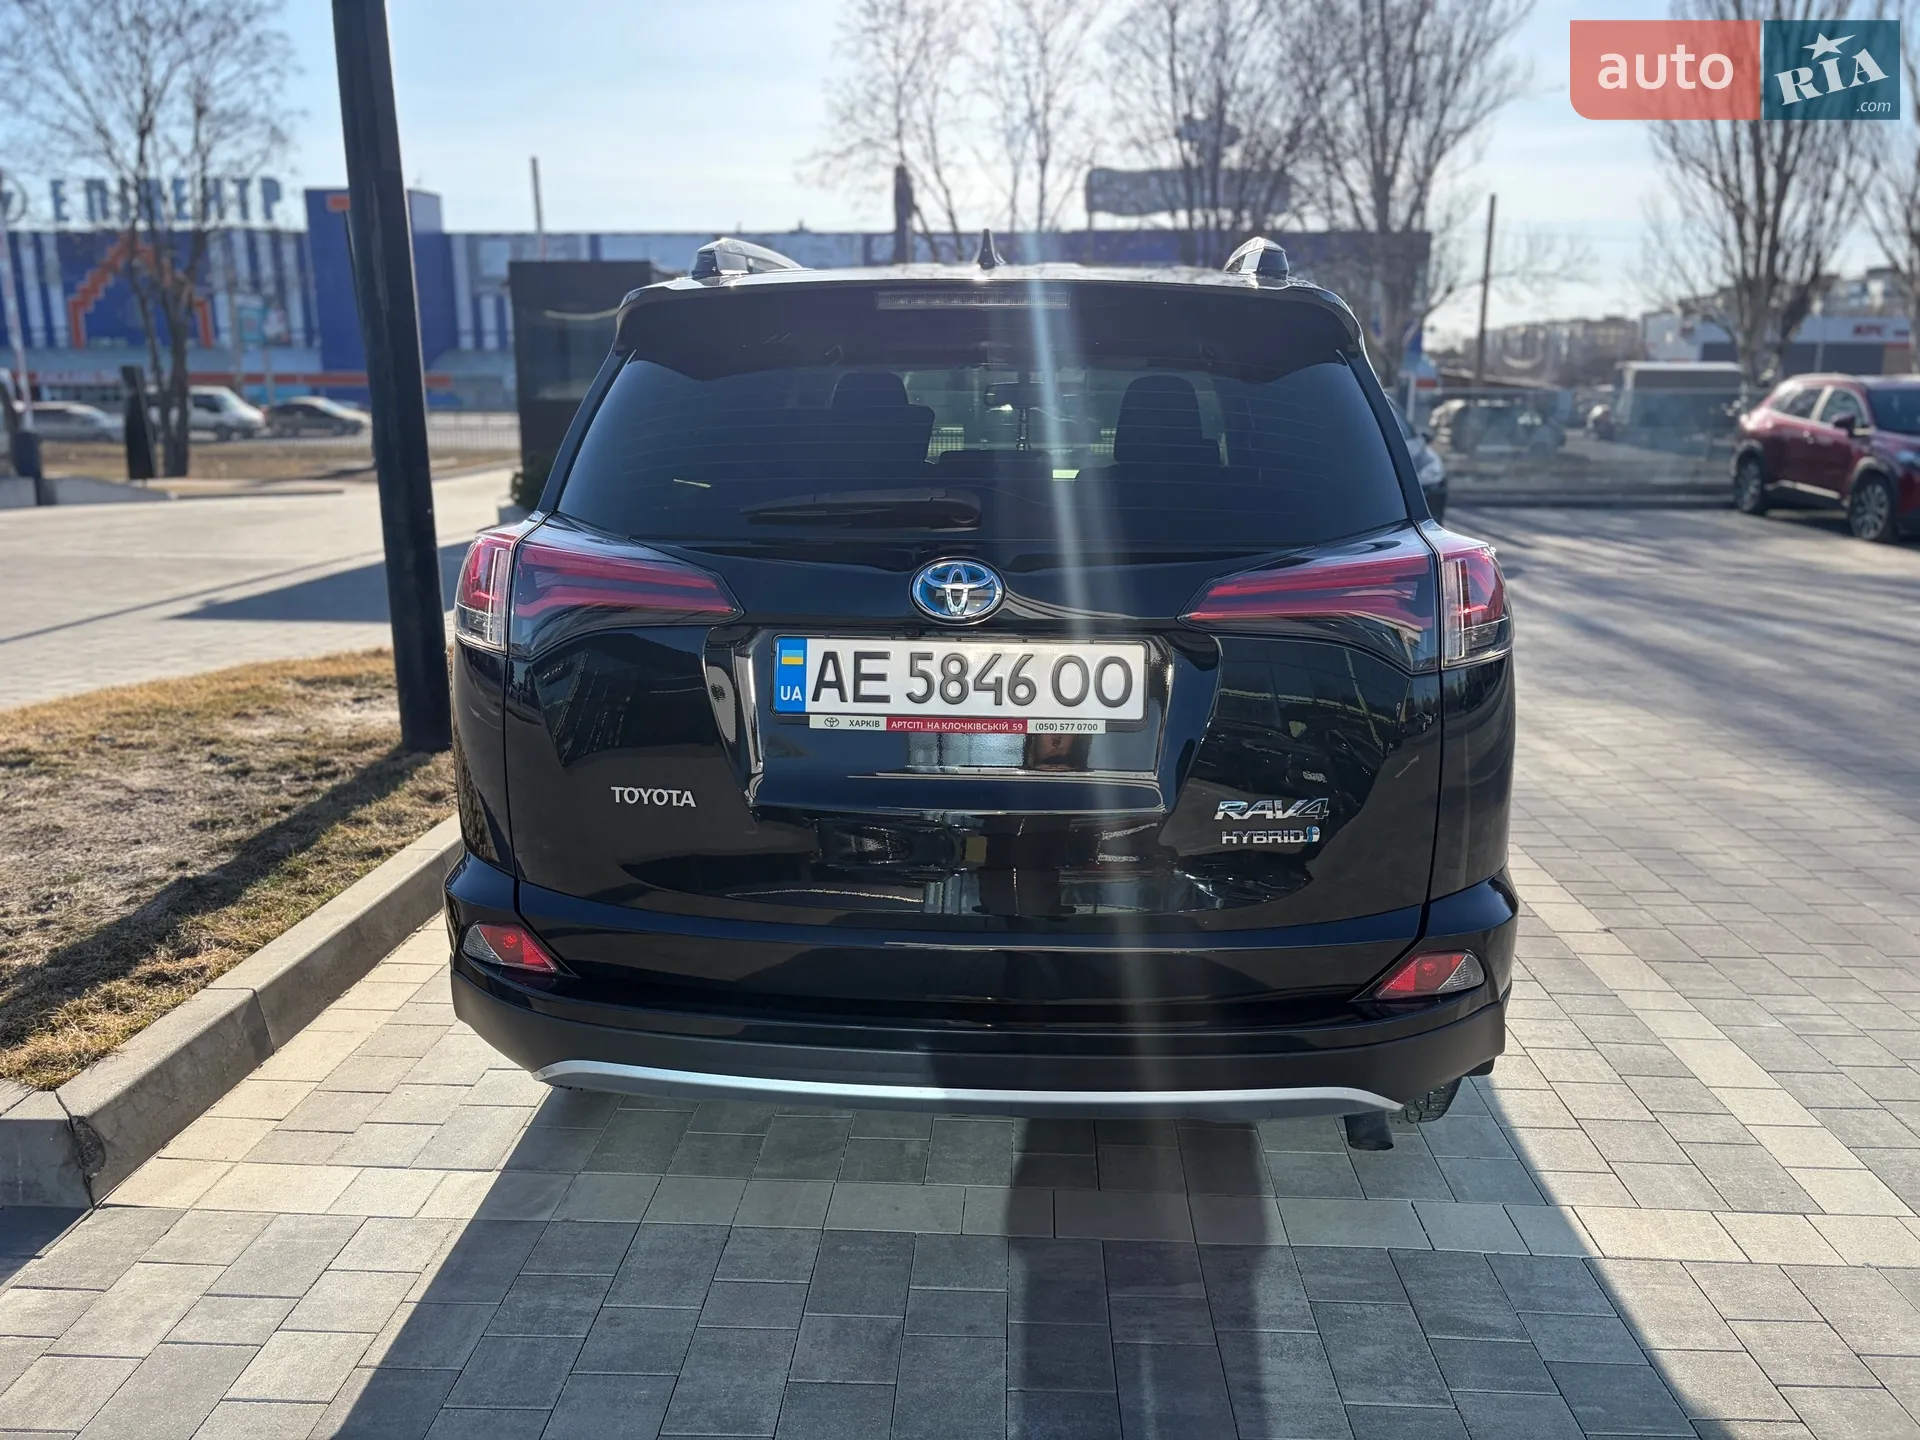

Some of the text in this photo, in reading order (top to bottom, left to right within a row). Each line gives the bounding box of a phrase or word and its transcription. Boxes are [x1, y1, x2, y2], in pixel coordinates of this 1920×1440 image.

[811, 651, 891, 703] AE
[906, 652, 1037, 707] 5846
[780, 685, 803, 701] UA
[848, 719, 880, 728] ХАРКІВ
[890, 721, 1023, 731] АРТСІТІ НА КЛОЧКІВСЬКІЙ 59
[1035, 723, 1098, 732] (050) 577 0700
[610, 785, 697, 808] TOYOTA
[1213, 797, 1330, 820] RAV4
[1221, 829, 1305, 844] HYBRID
